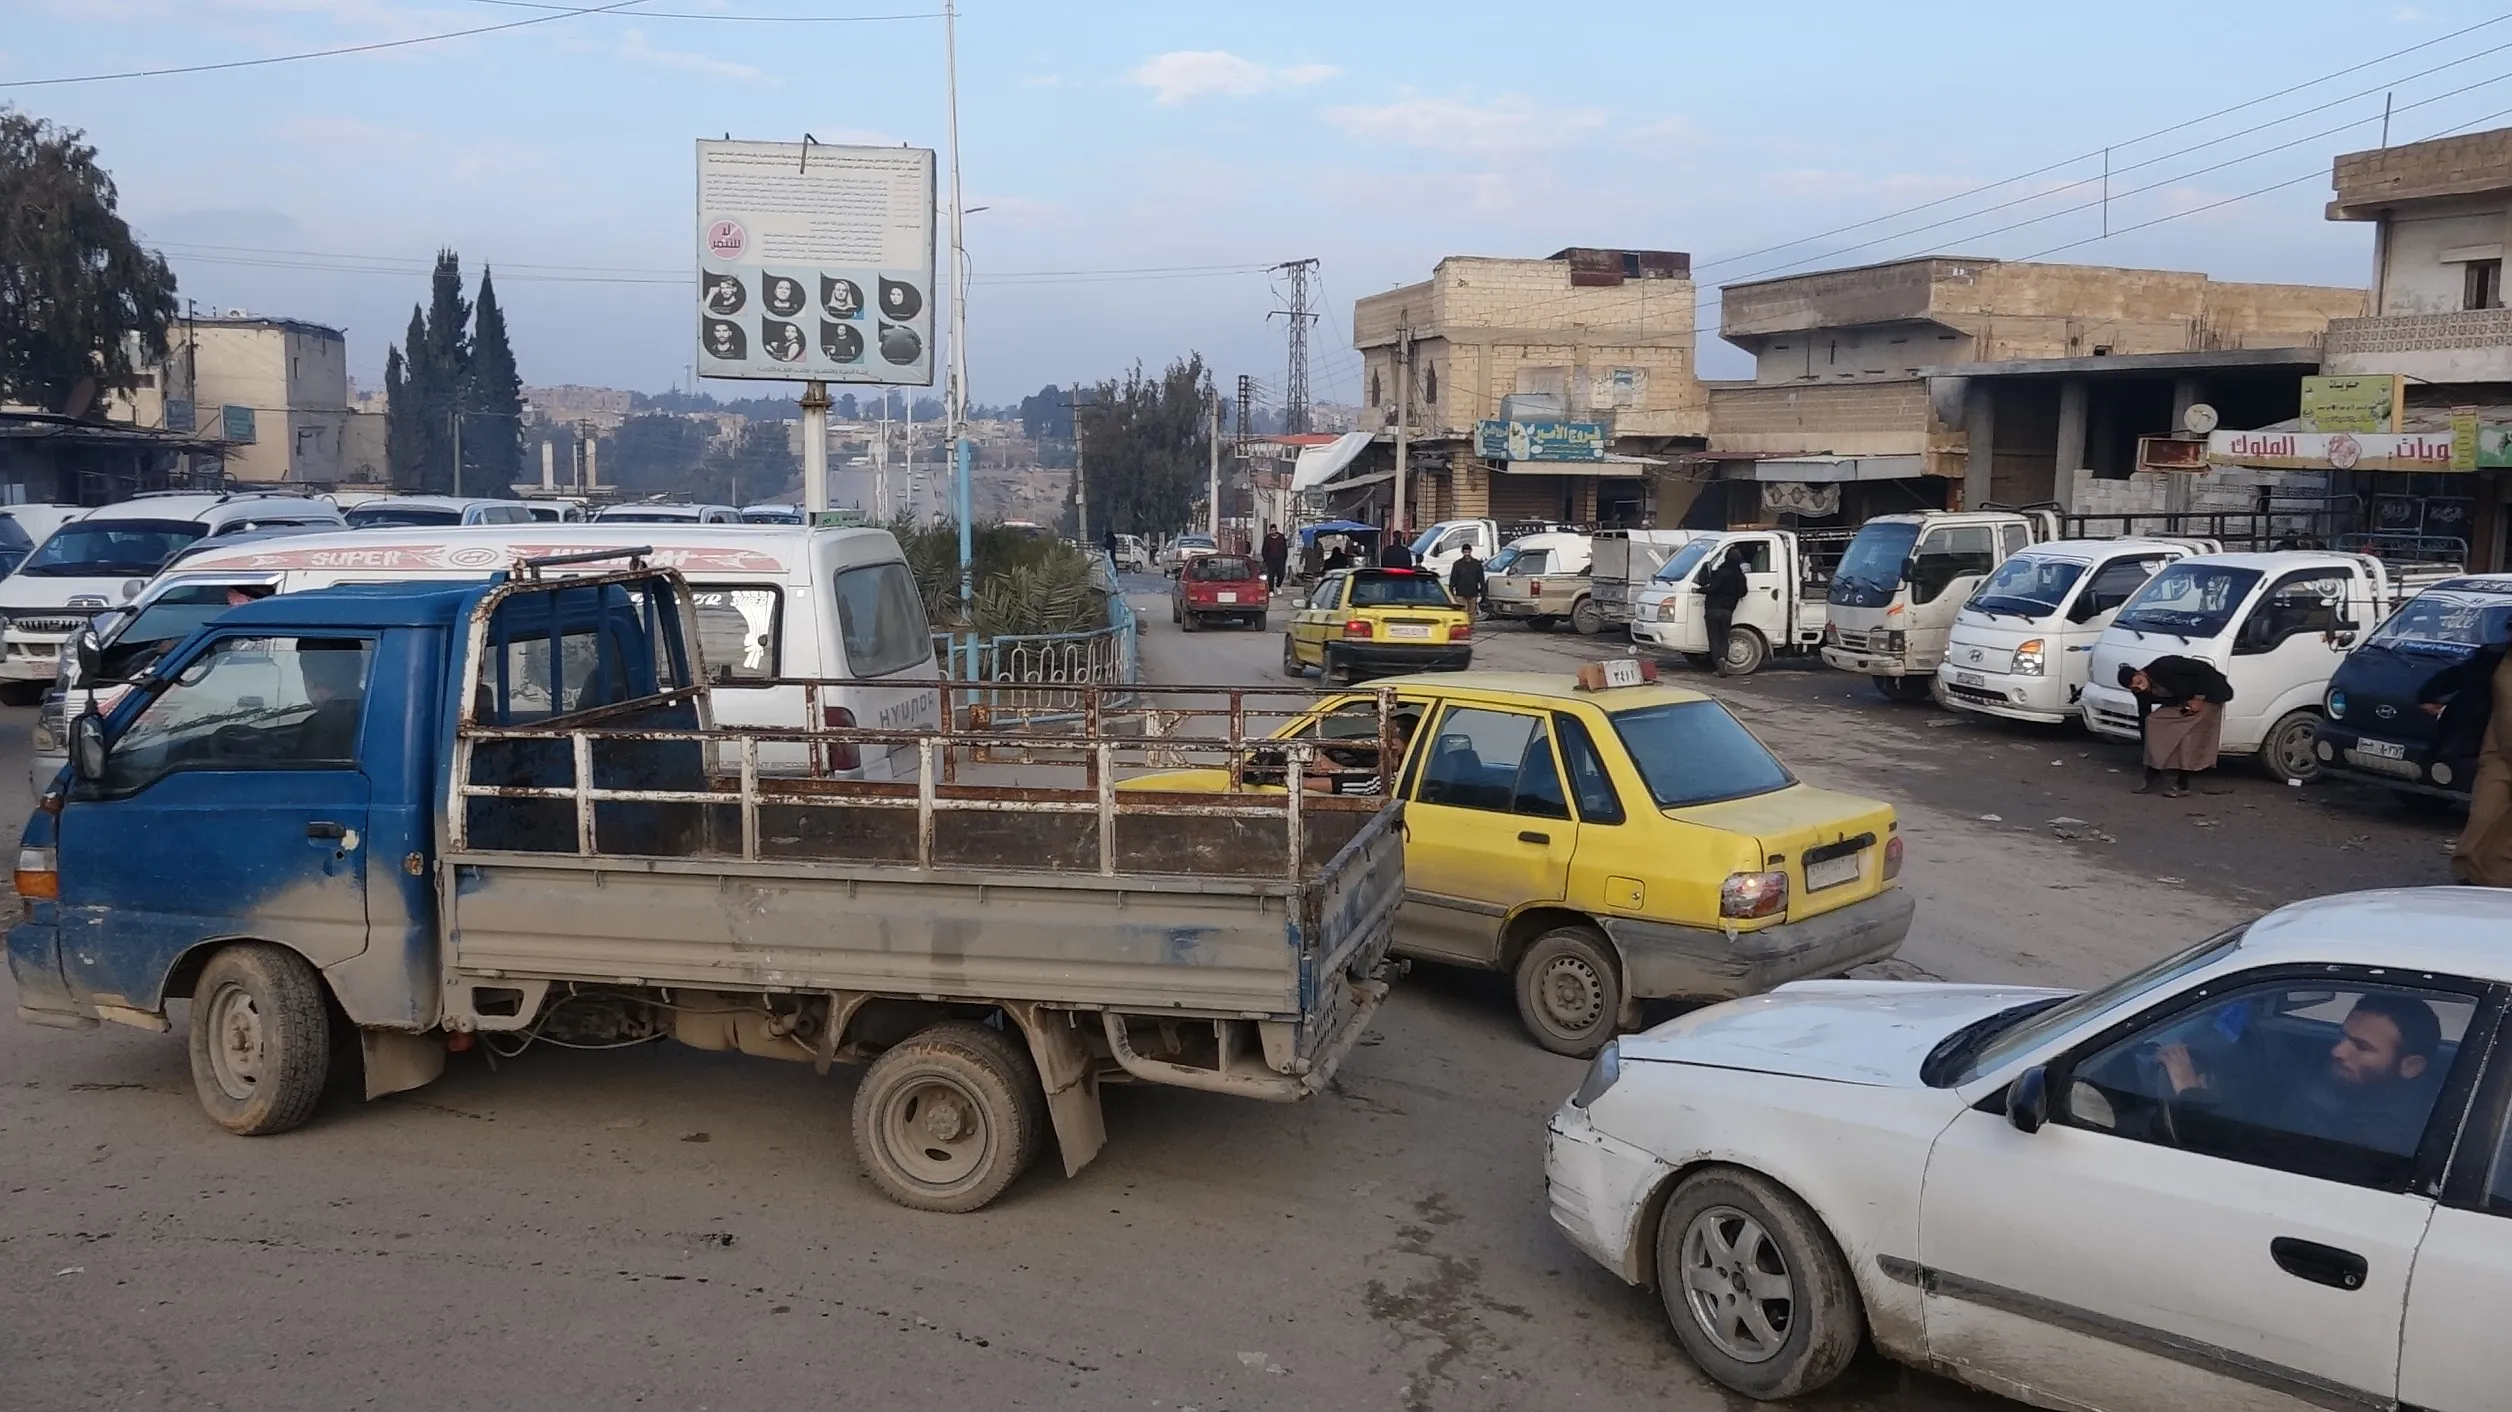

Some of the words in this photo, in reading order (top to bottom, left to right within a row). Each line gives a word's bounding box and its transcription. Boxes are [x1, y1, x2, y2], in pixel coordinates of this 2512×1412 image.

[722, 224, 731, 236] لا
[711, 238, 741, 250] للتنمر
[2230, 434, 2295, 459] الملوك
[311, 550, 402, 567] SUPER
[879, 690, 933, 729] HYUNDA
